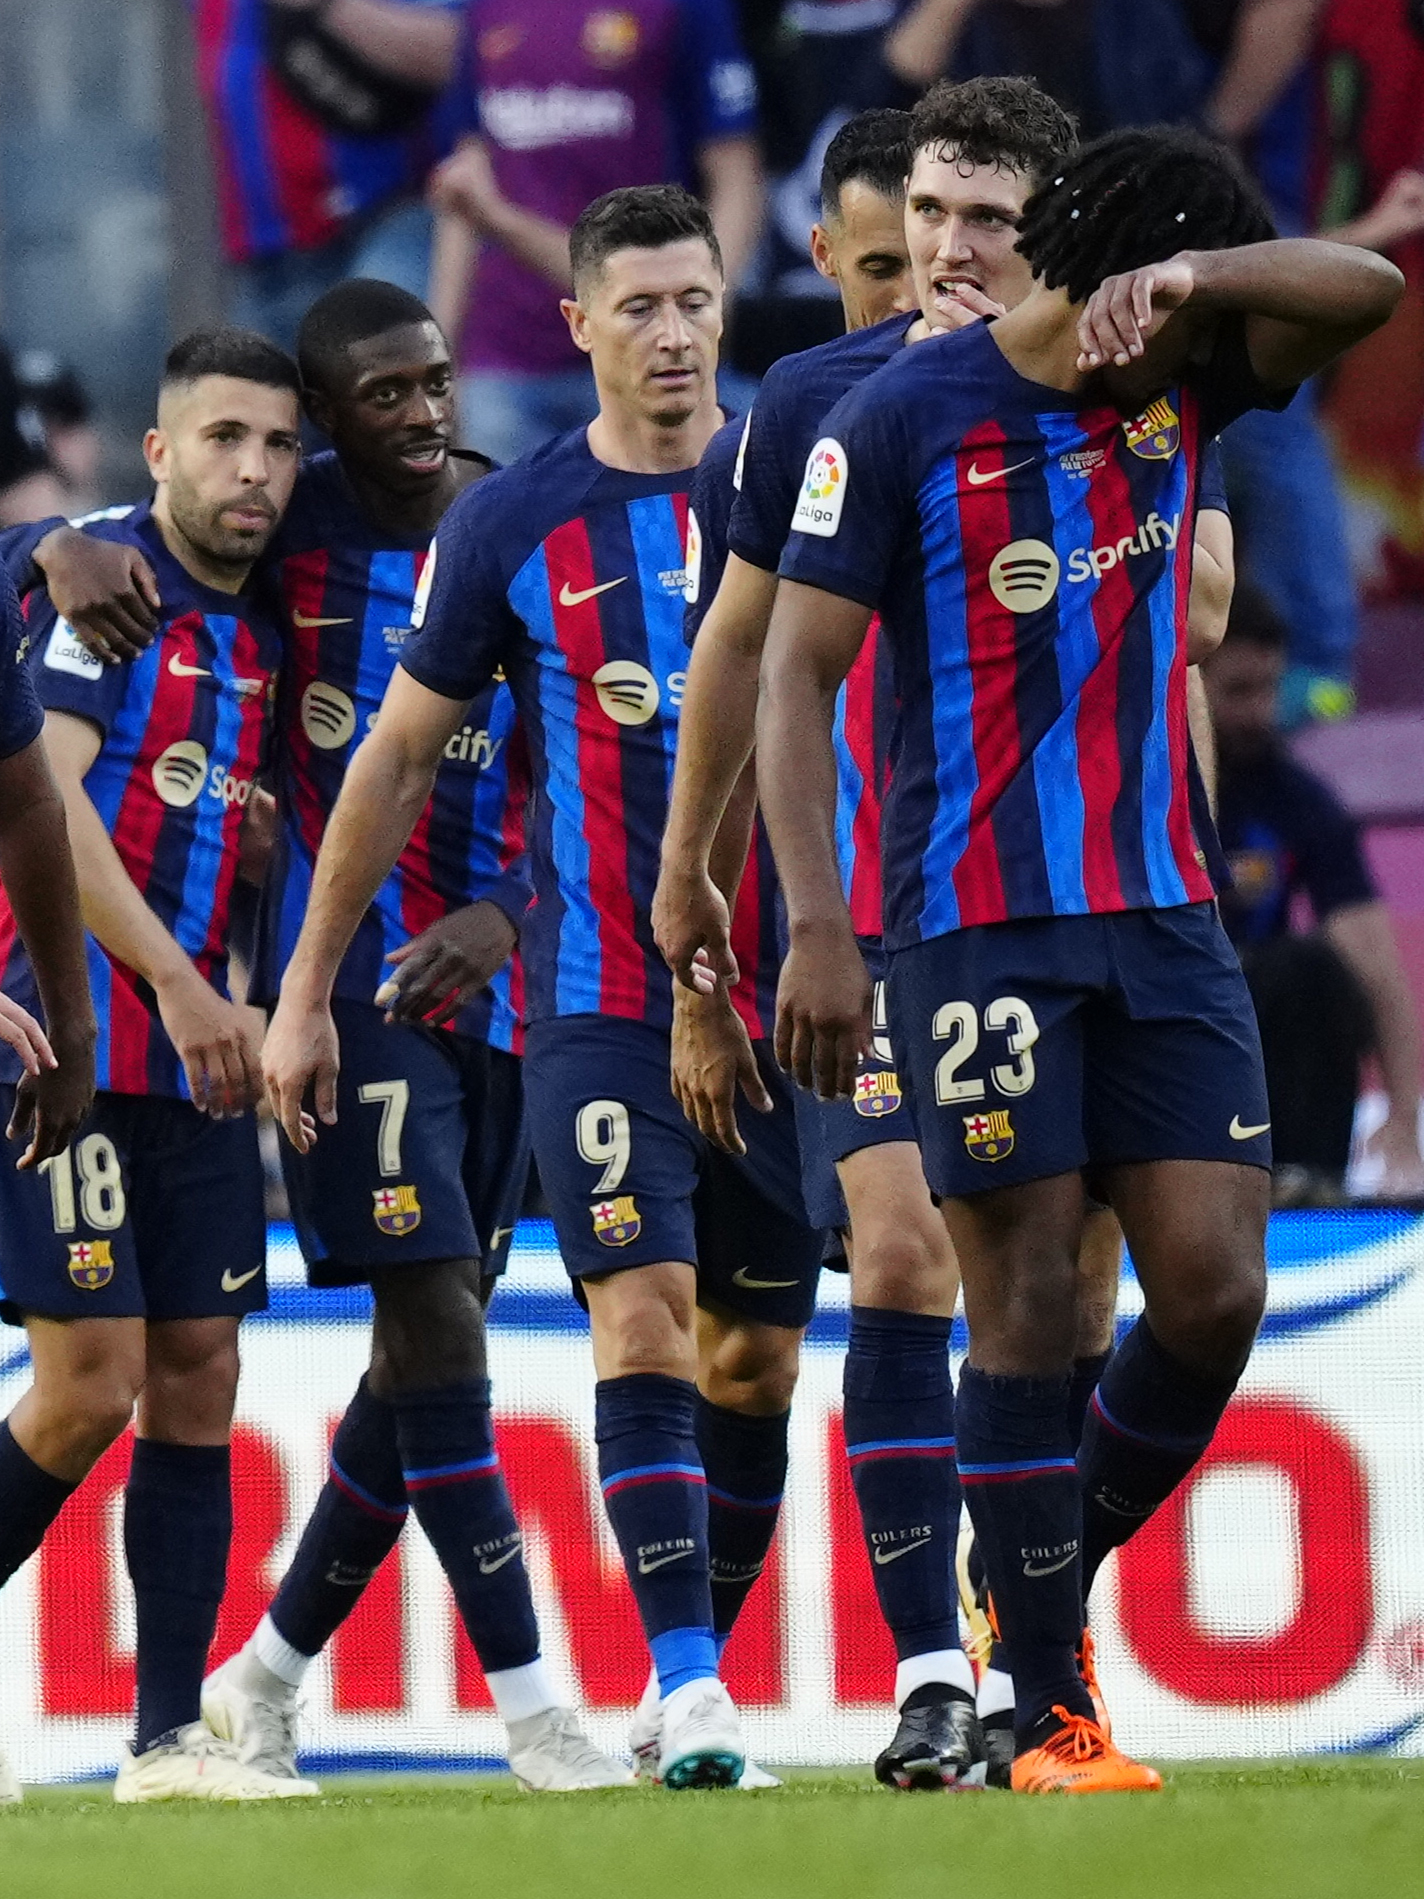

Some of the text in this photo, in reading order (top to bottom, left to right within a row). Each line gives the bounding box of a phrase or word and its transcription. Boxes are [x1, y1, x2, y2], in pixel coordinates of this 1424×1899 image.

[796, 504, 833, 522] aLiga
[931, 996, 1040, 1107] 23
[357, 1078, 410, 1178] 7
[575, 1099, 631, 1195] 9
[37, 1132, 126, 1234] 18
[871, 1524, 932, 1545] CULERS
